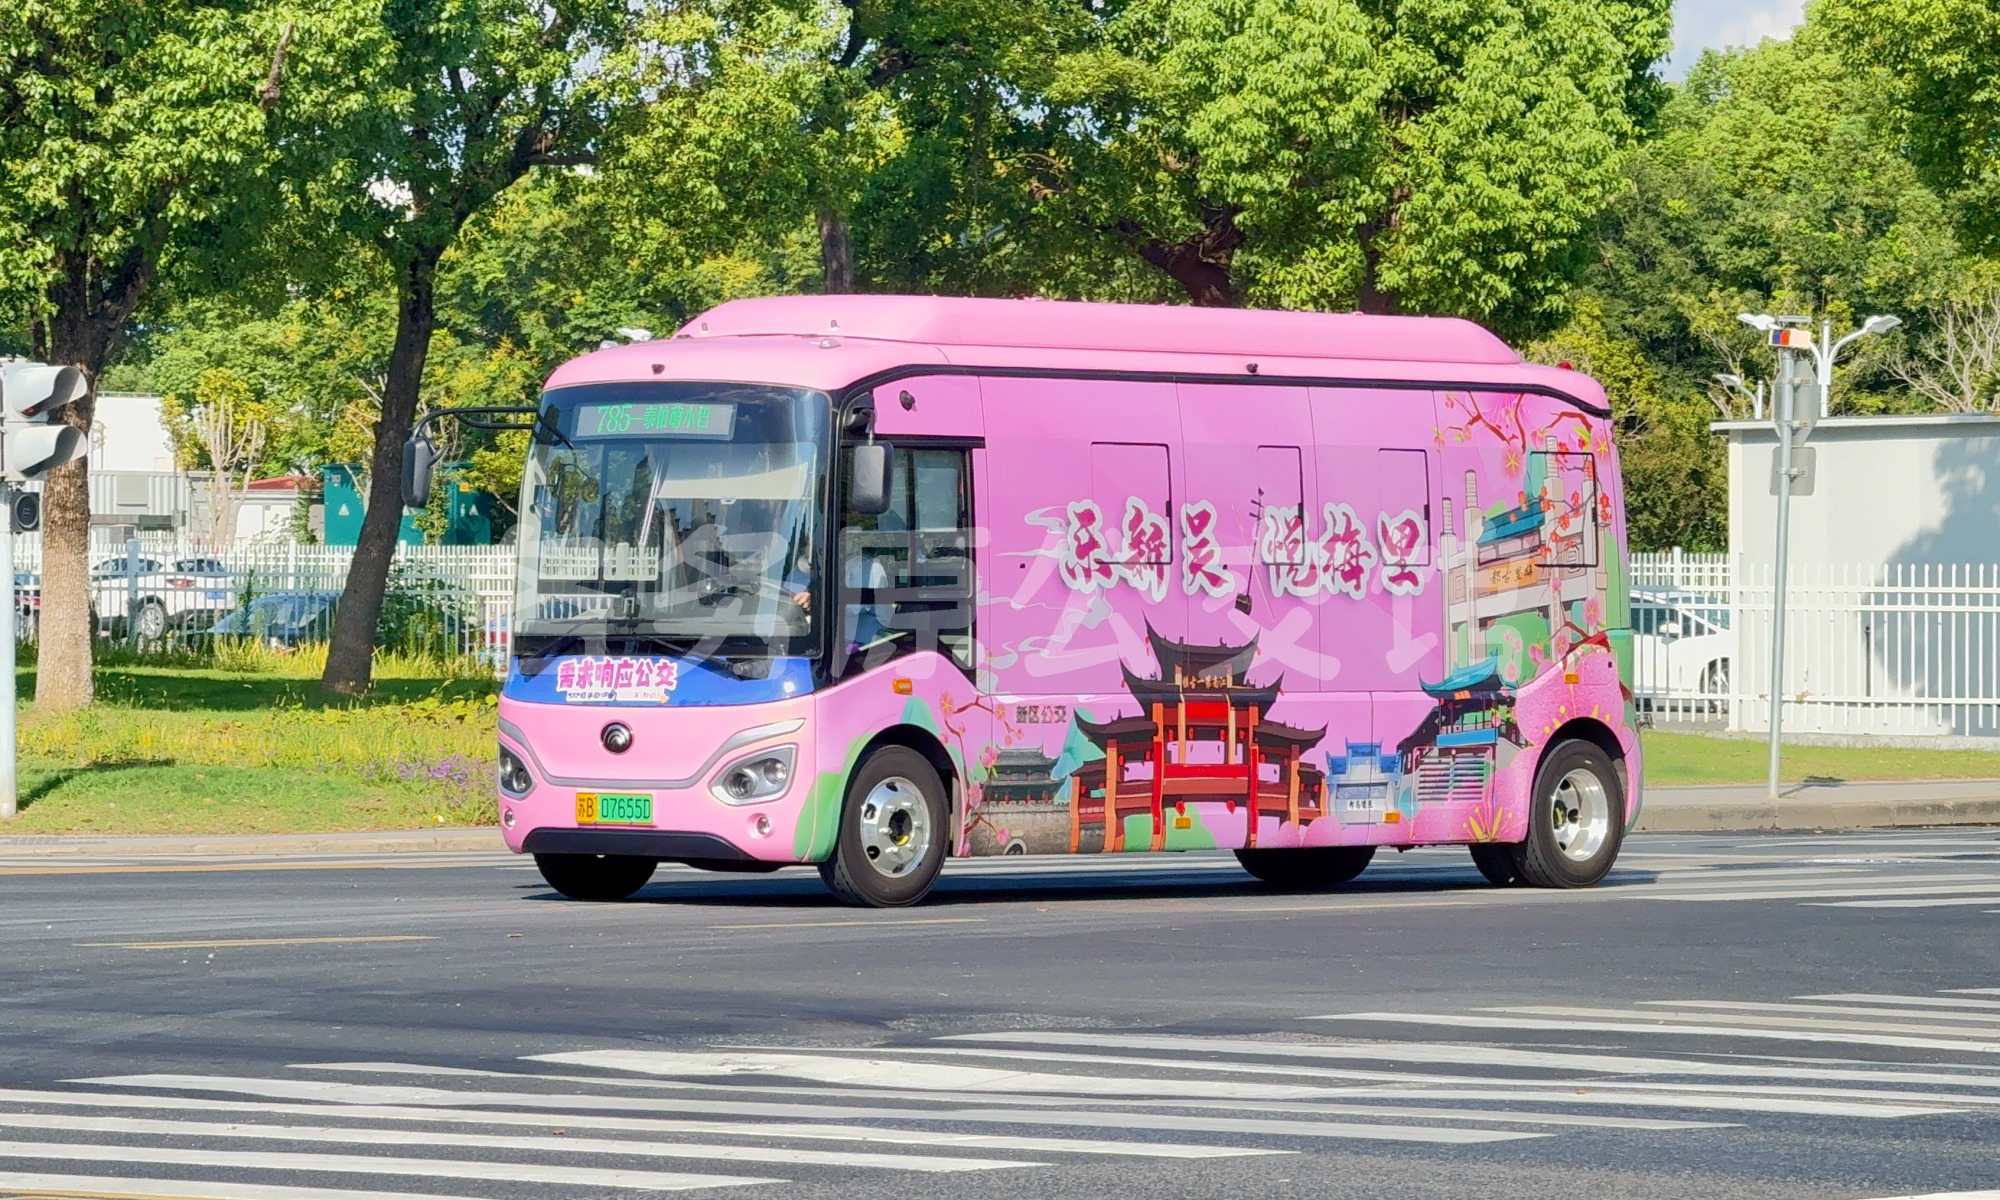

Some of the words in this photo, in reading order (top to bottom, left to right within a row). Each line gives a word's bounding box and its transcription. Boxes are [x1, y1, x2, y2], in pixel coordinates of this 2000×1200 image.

[1265, 510, 1422, 593] 悦梅里
[558, 659, 676, 689] 需求响应公交
[1016, 705, 1067, 724] 新区公交
[578, 797, 595, 818] 苏B
[601, 798, 651, 819] 07655D
